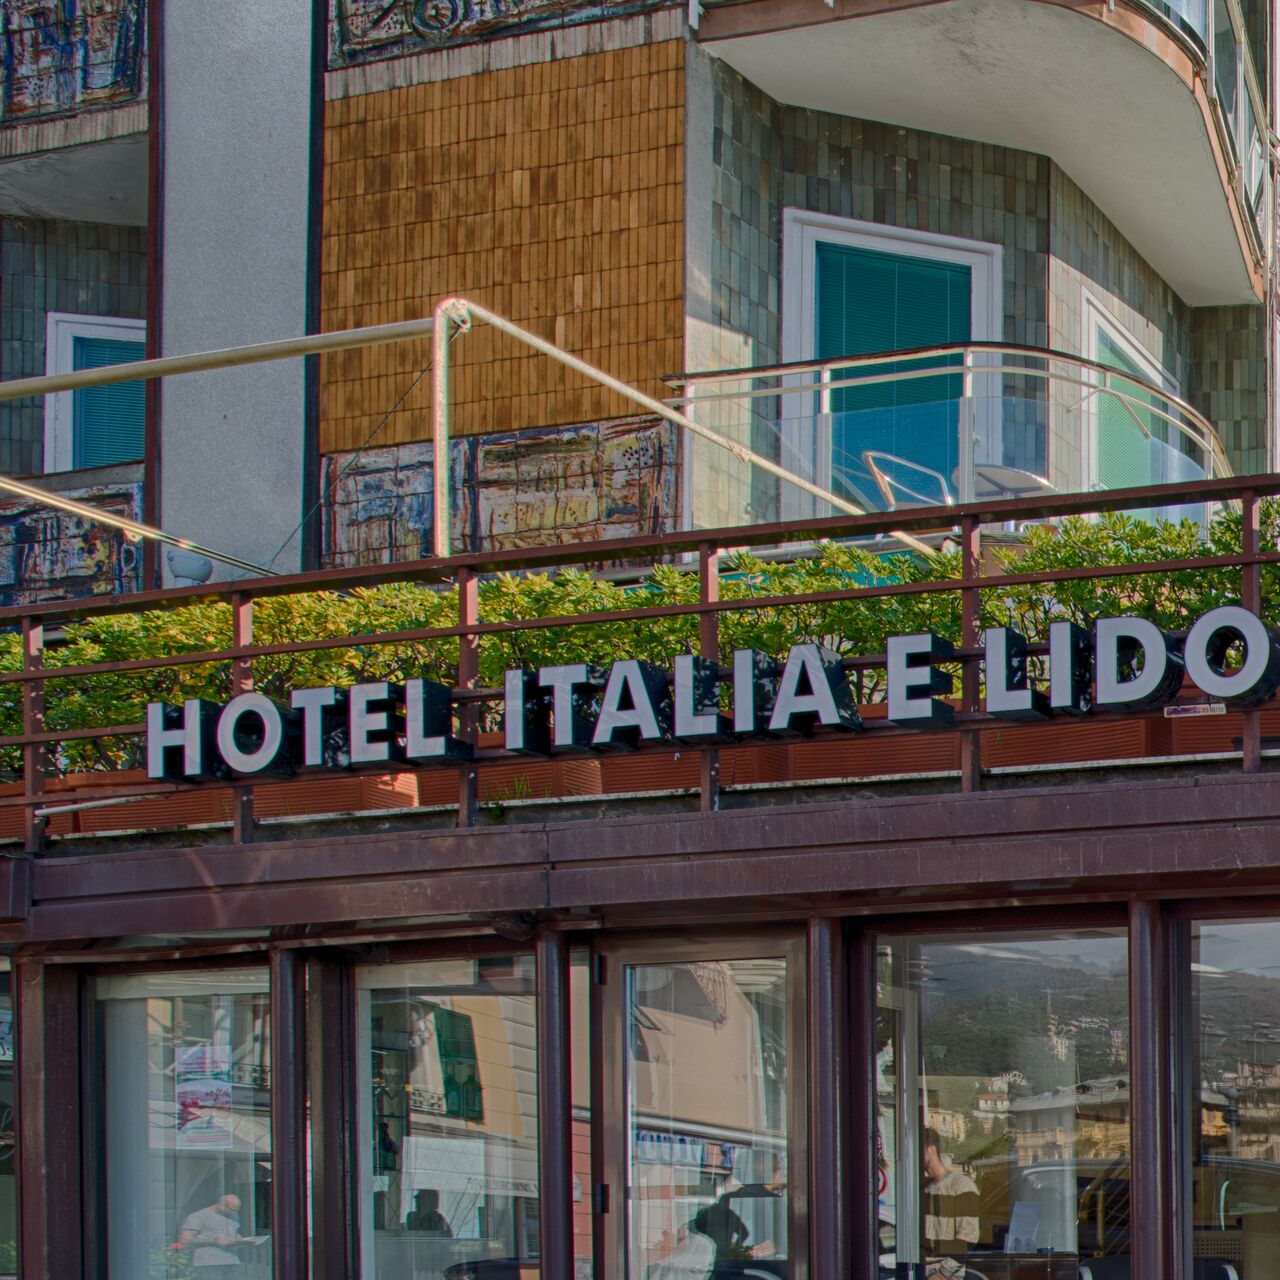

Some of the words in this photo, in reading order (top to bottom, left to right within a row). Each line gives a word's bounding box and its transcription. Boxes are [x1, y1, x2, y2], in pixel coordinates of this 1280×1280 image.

[146, 679, 446, 779] HOTEL
[505, 643, 842, 752] ITALIA
[887, 633, 933, 721] E
[985, 605, 1273, 714] LIDO
